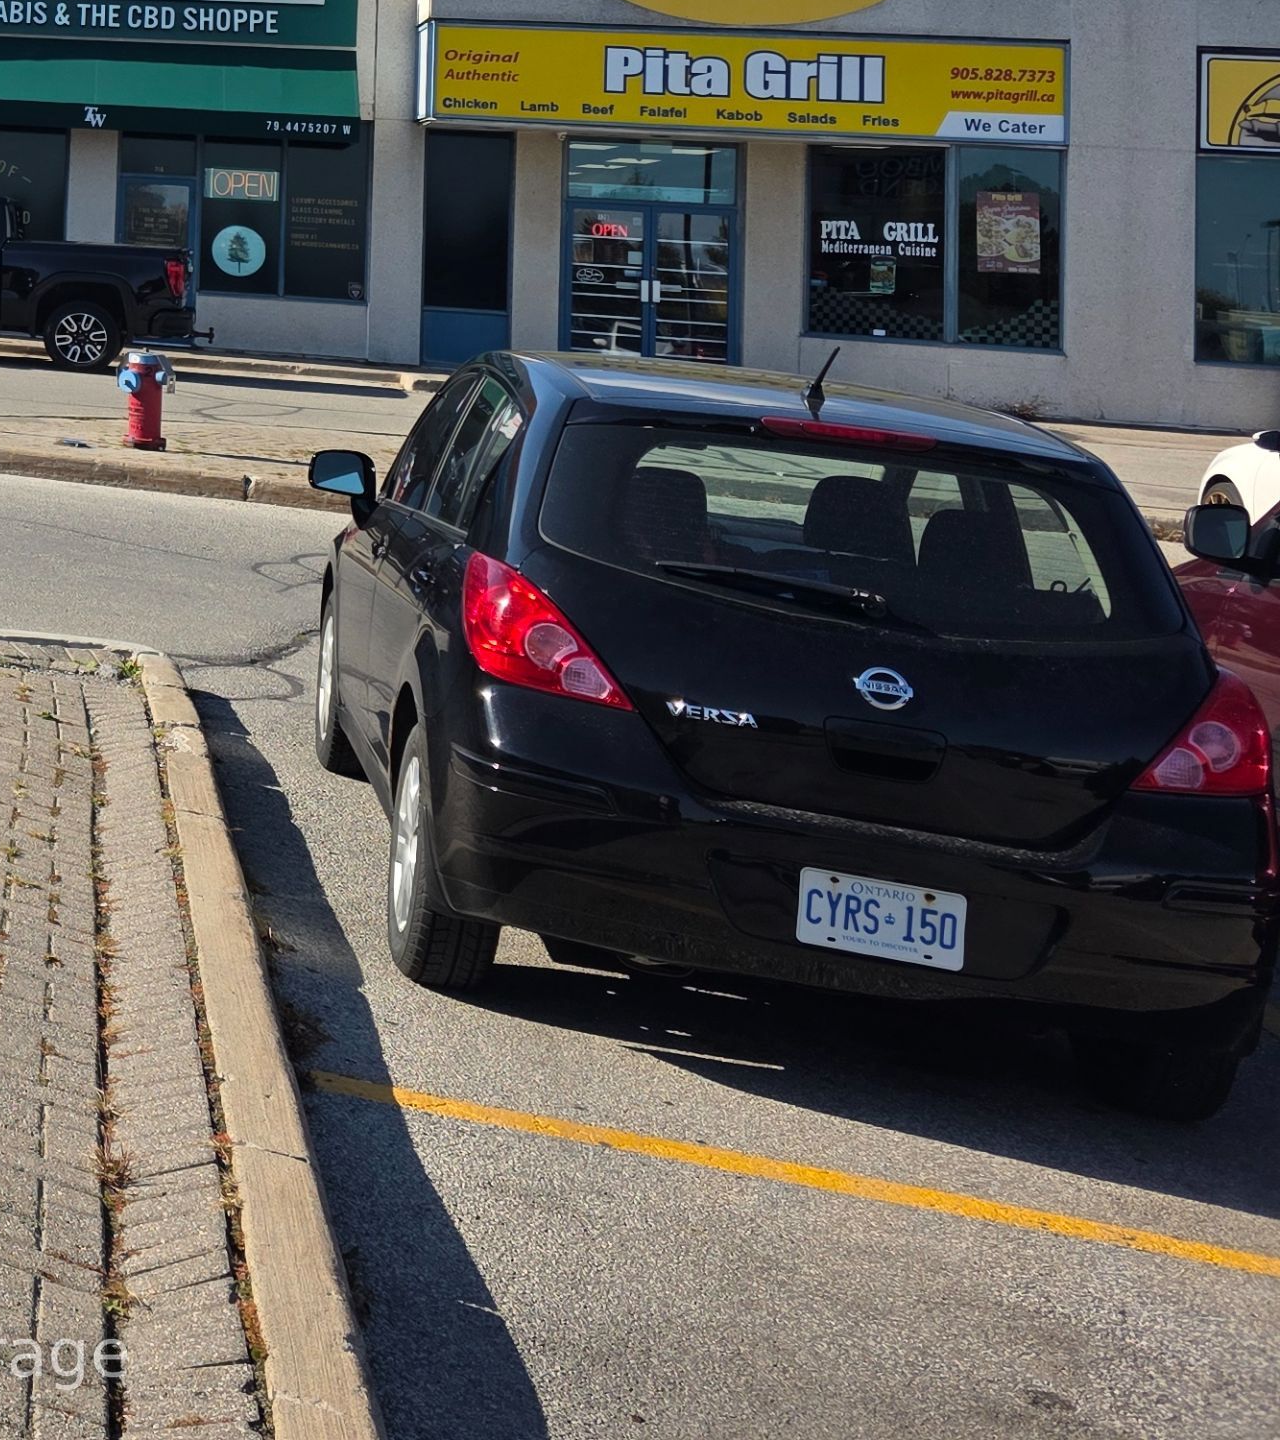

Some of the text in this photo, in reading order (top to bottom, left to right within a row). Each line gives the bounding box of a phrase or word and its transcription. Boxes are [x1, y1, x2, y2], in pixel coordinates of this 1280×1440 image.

[54, 4, 70, 26] &
[77, 4, 120, 27] THE
[128, 6, 176, 30] CBD
[183, 8, 279, 34] SHOPPE
[444, 49, 519, 65] Original
[444, 69, 519, 82] Authentic
[604, 45, 886, 104] Pita Grill
[950, 67, 1055, 83] 905.828.7373
[951, 89, 1055, 103] www.pitagrill.ca
[442, 97, 899, 127] Chicken Lamb Beef Falafel Kabob Salads Fries
[267, 120, 351, 135] 79.4475207 W
[965, 118, 1046, 134] We Cater
[213, 171, 275, 197] OPEN
[592, 223, 629, 237] OPEN
[820, 220, 939, 243] PITA GRILL
[821, 240, 937, 257] Mediterranean Cuisine
[862, 680, 908, 696] NISSAN
[665, 699, 758, 729] VERSA
[851, 881, 915, 903] ONTARIO
[805, 889, 957, 950] CYRS 150
[842, 935, 866, 945] YOURS
[881, 942, 919, 953] DISCOVER
